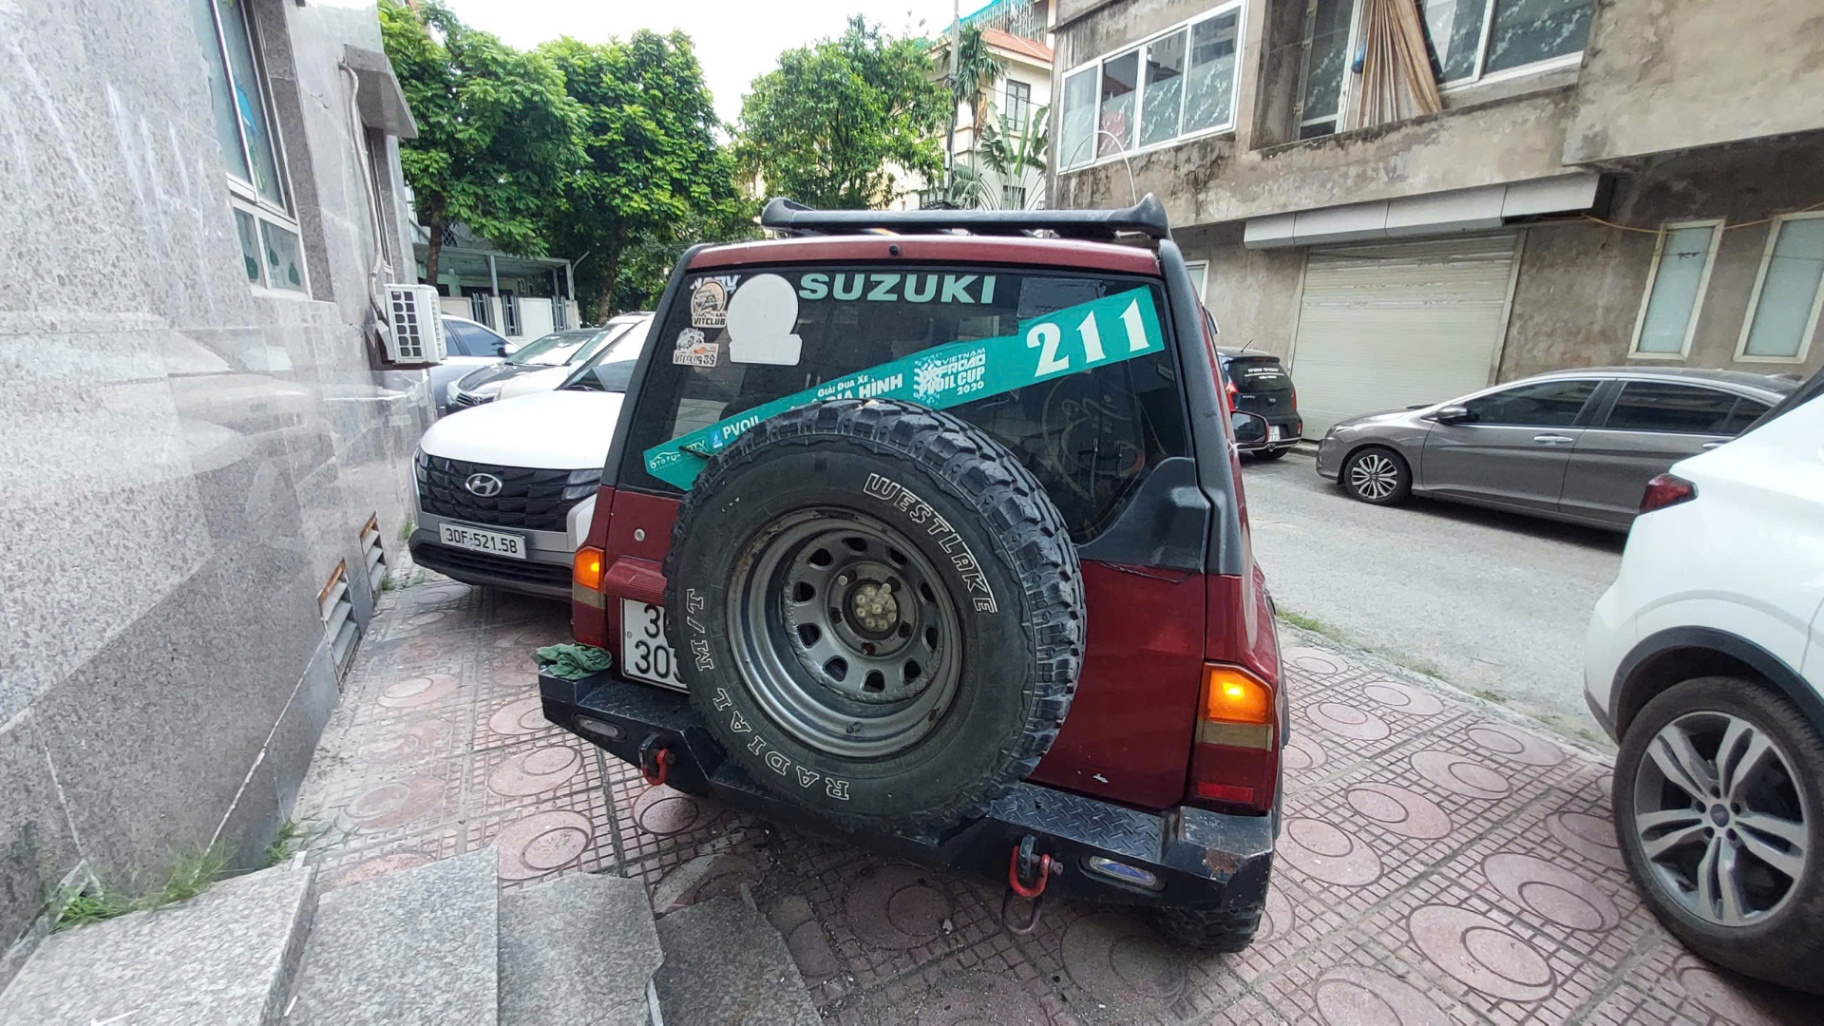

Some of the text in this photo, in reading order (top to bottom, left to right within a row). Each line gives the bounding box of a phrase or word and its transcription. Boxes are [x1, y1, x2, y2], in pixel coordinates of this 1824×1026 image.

[799, 274, 997, 304] SUZUKI
[694, 317, 726, 325] VITCLUB
[1026, 298, 1151, 378] 211
[942, 347, 986, 365] VIETNAM
[859, 373, 904, 399] HÌNH
[956, 381, 985, 396] 2020
[957, 366, 986, 387] CUP
[446, 528, 518, 554] 30F-521.58
[863, 472, 999, 614] WESTLAKE
[644, 603, 668, 639] 3
[634, 639, 687, 684] 30
[712, 687, 850, 800] RADIAL
